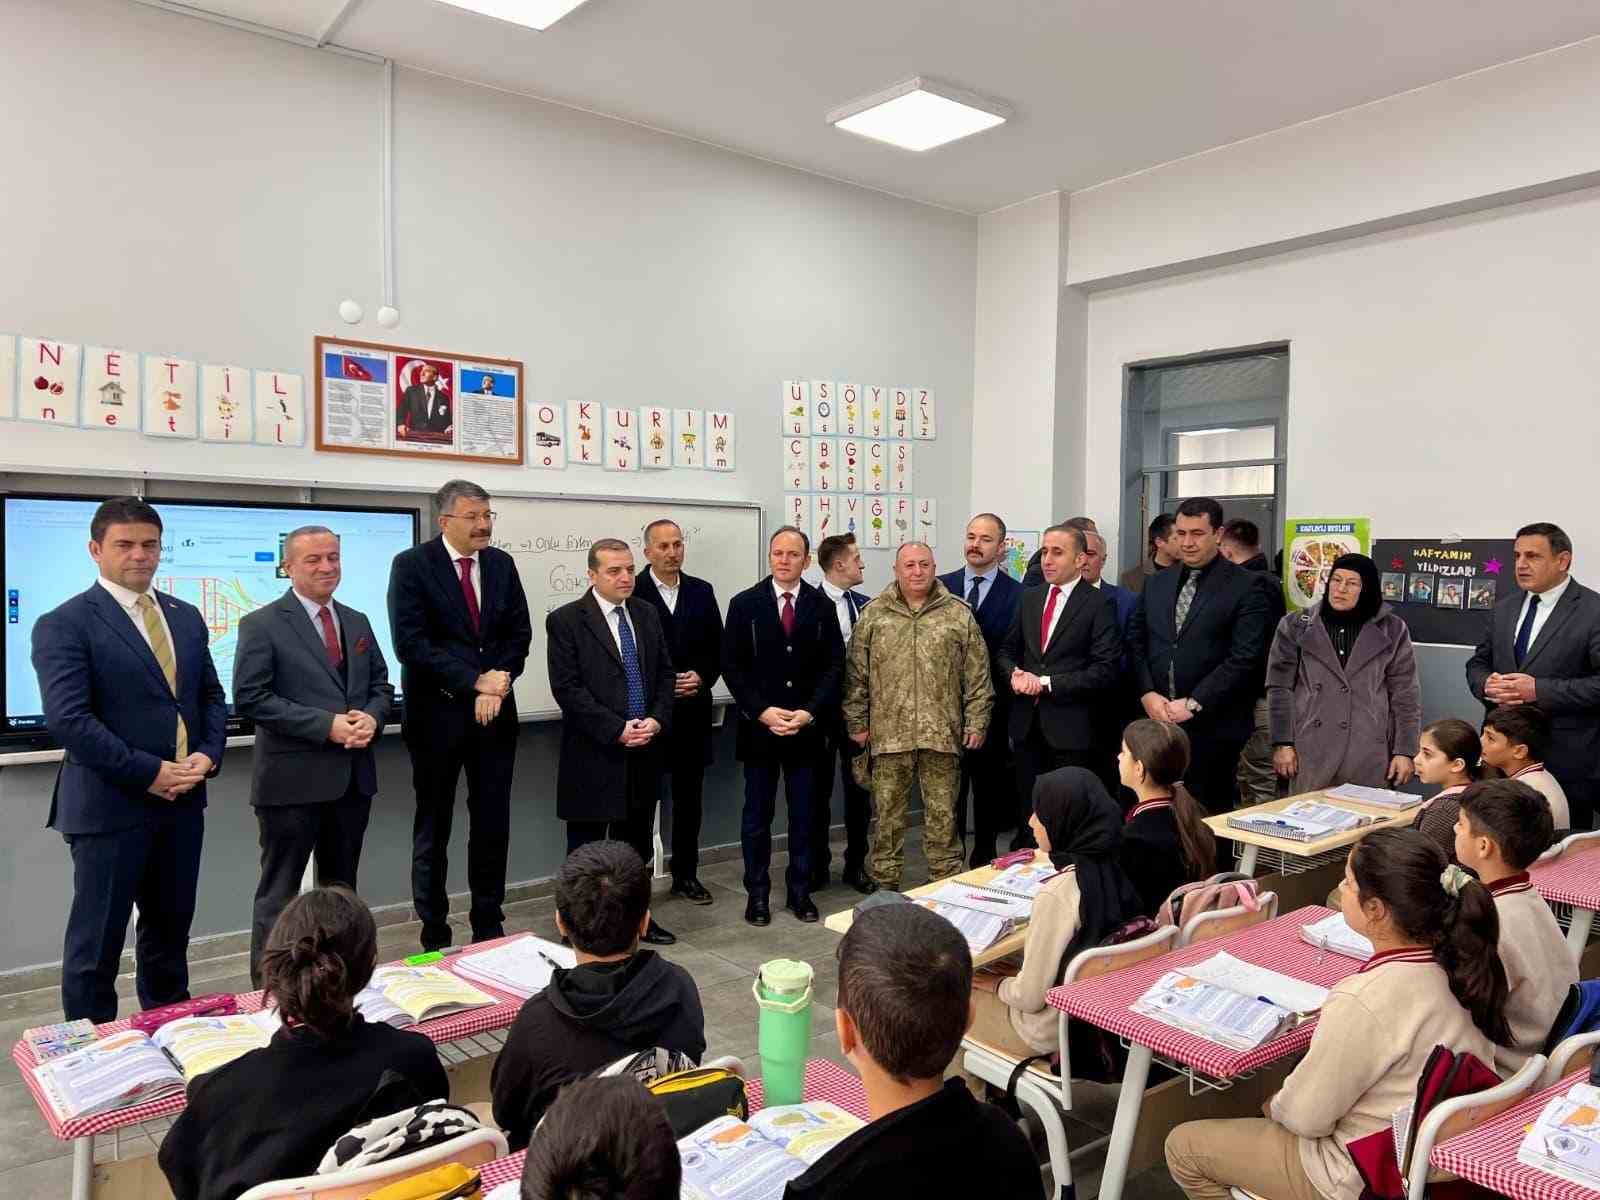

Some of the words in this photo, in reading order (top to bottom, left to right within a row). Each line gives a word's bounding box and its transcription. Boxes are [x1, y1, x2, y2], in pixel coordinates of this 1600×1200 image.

[40, 343, 61, 366] N
[107, 354, 121, 376] E
[164, 362, 180, 384] T
[273, 375, 287, 395] L
[820, 384, 827, 399] S
[844, 385, 856, 403] Ö
[871, 387, 881, 401] Y
[896, 391, 906, 405] D
[920, 391, 928, 405] Z
[42, 407, 56, 420] n
[105, 414, 118, 426] e
[168, 416, 176, 432] t
[277, 424, 283, 443] l
[538, 407, 554, 424] O
[579, 402, 591, 420] K
[617, 411, 629, 428] U
[652, 411, 661, 428] R
[713, 414, 728, 429] M
[873, 426, 880, 437] y
[897, 424, 904, 438] d
[921, 428, 928, 436] z
[543, 456, 552, 466] o
[581, 444, 590, 461] k
[618, 457, 627, 468] u
[654, 456, 661, 465] r
[716, 457, 727, 467] m
[820, 442, 829, 457] B
[845, 442, 857, 457] G
[871, 443, 881, 458] C
[822, 475, 829, 490] b
[847, 477, 854, 490] g
[874, 482, 881, 491] c
[794, 497, 802, 513] P
[820, 498, 830, 512] H
[847, 498, 857, 512] V
[899, 500, 905, 513] F
[921, 501, 929, 513] J
